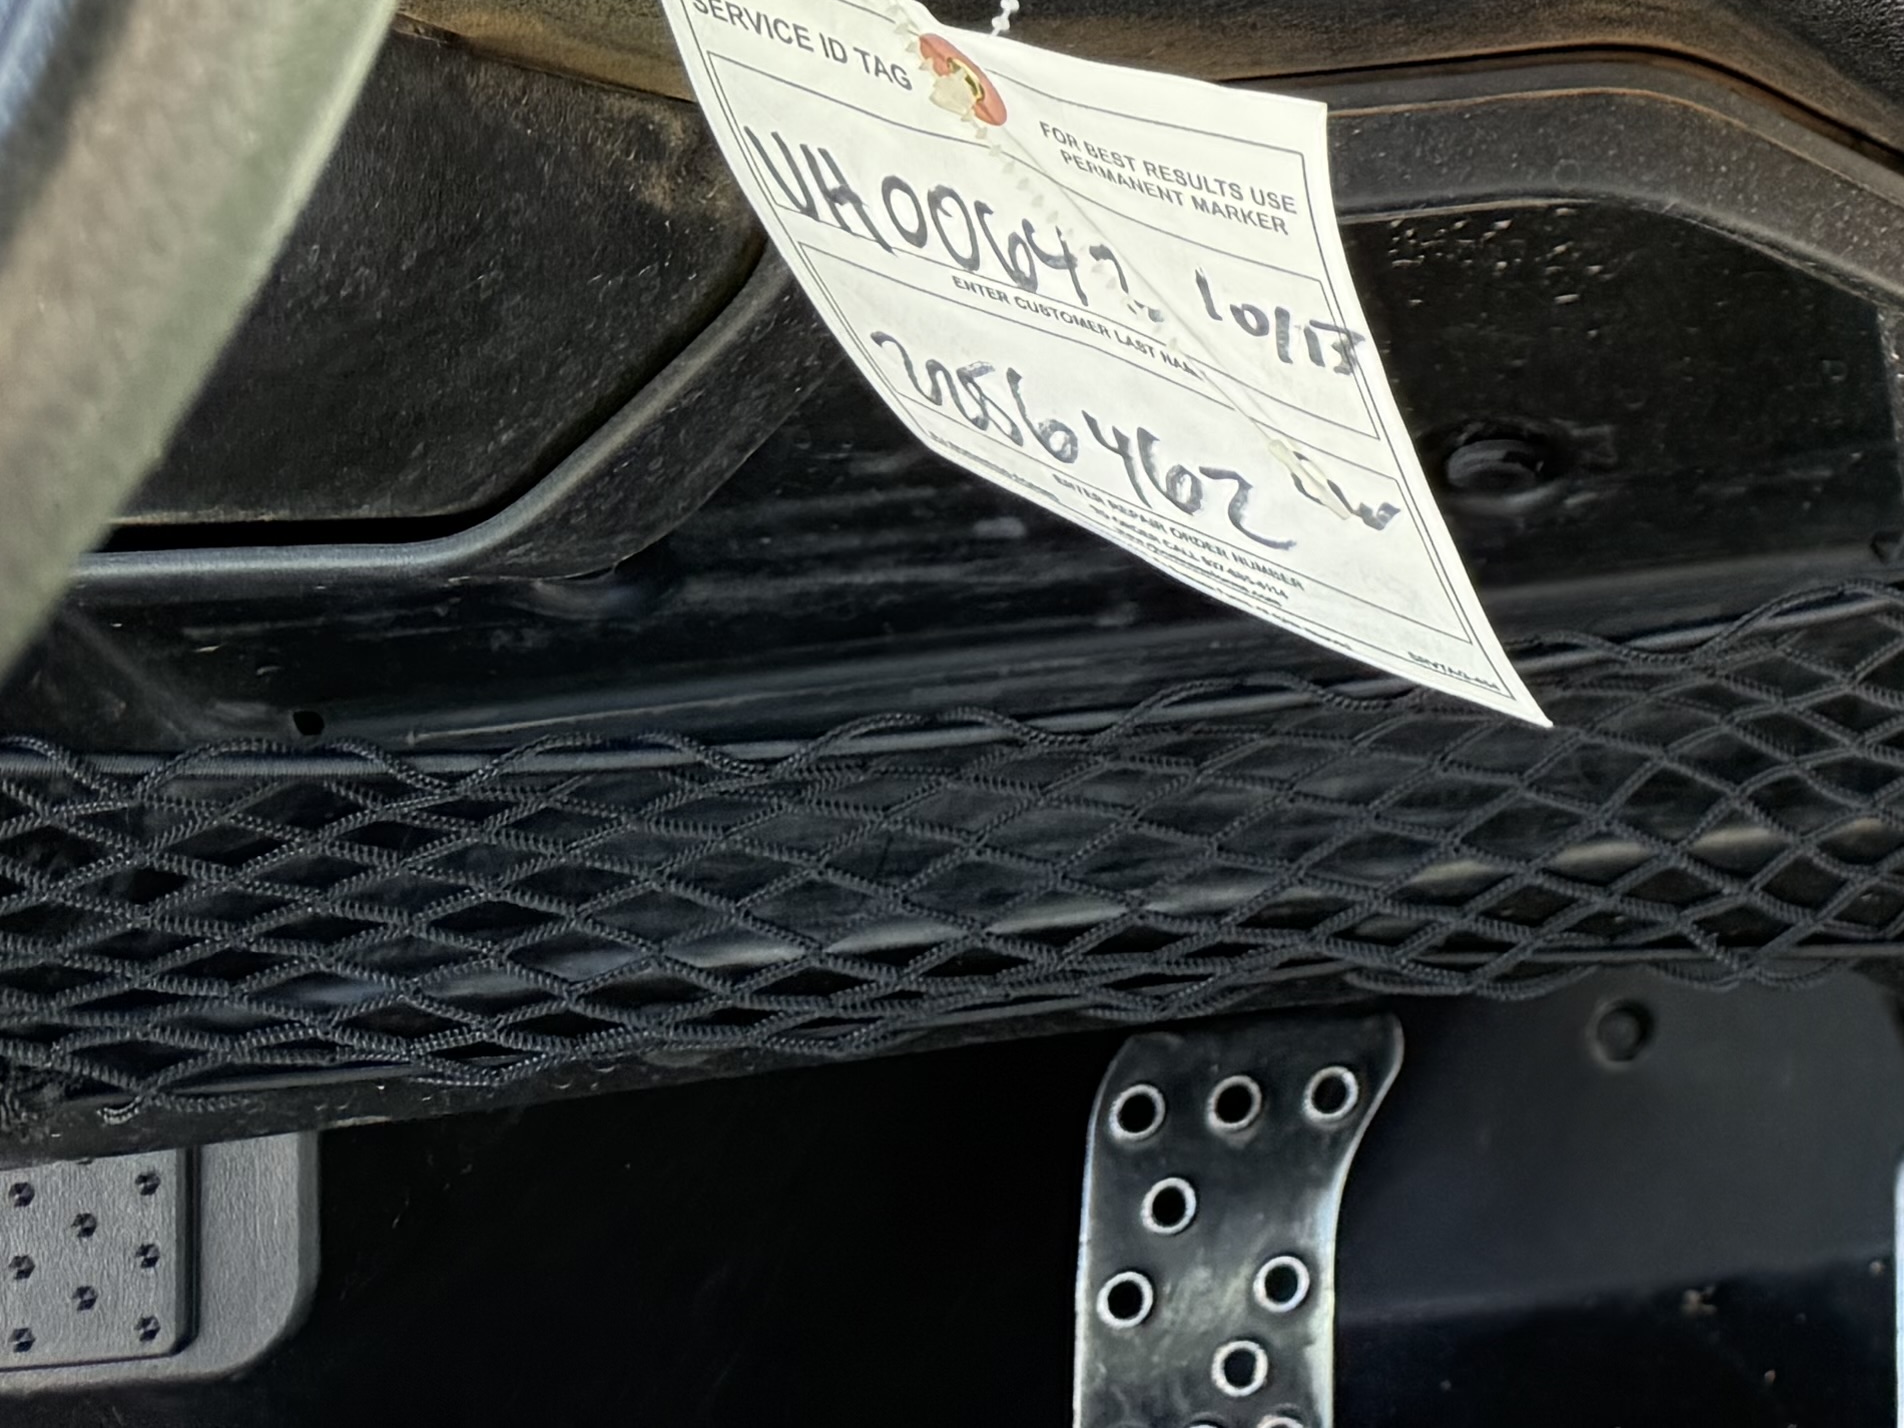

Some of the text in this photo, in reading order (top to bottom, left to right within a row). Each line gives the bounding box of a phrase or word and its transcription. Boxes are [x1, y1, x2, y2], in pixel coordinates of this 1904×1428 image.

[819, 33, 848, 64] ID
[853, 46, 913, 91] TAG
[1039, 121, 1298, 215] FOR BEST RESULTS USE
[1060, 149, 1289, 236] PERMANENT MARKER
[952, 275, 1010, 306] ENTER
[1015, 295, 1111, 339] CUSTOMER
[1115, 327, 1155, 359] LAST
[1169, 525, 1229, 562] ORDER
[1229, 550, 1305, 591] NUMBER
